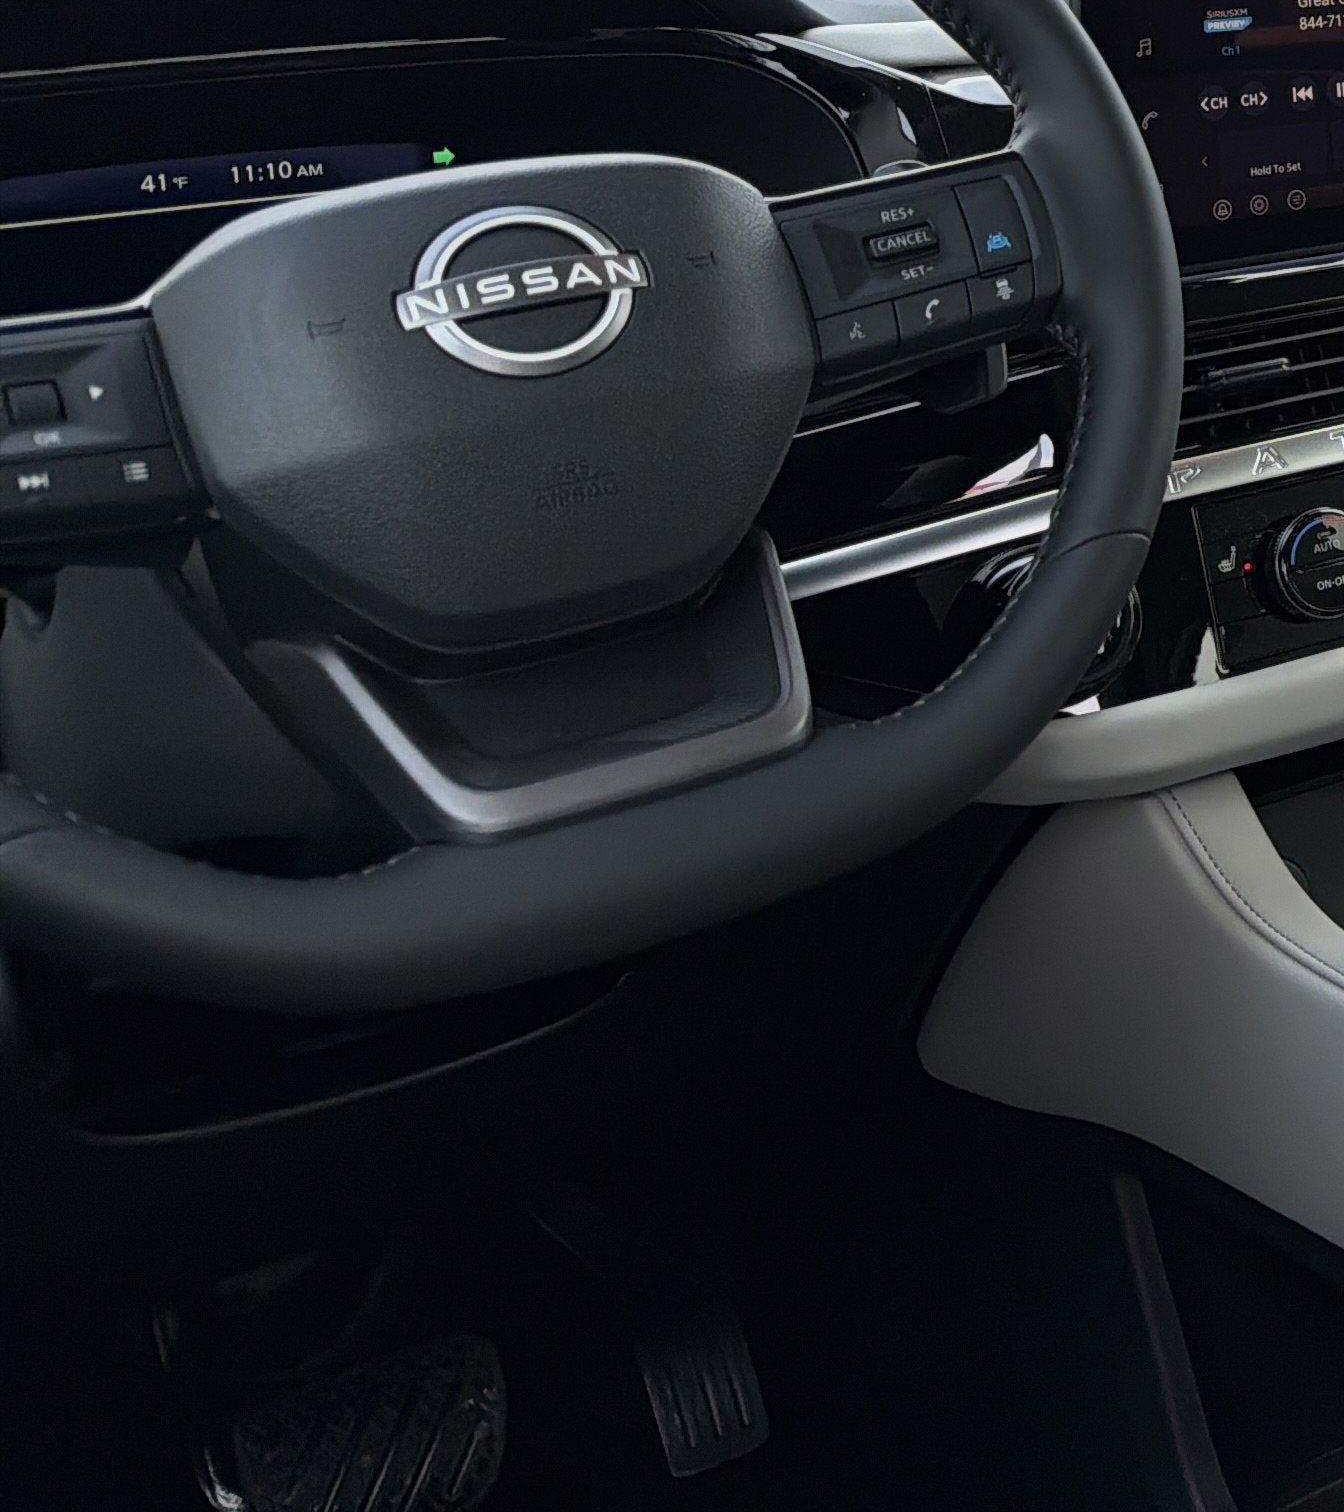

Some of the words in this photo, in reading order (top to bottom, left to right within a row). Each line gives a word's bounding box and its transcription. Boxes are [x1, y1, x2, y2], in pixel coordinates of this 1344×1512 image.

[1221, 45, 1234, 56] Ch
[140, 172, 169, 194] 41
[172, 173, 189, 190] °F
[231, 162, 294, 185] 11:10
[296, 162, 324, 178] AM
[1250, 165, 1272, 178] Hold
[1273, 164, 1285, 175] To
[1286, 161, 1302, 174] Set
[881, 206, 916, 224] RES+
[876, 231, 932, 253] CANCEL
[406, 254, 642, 323] NISSAN
[1313, 538, 1341, 555] AUTO
